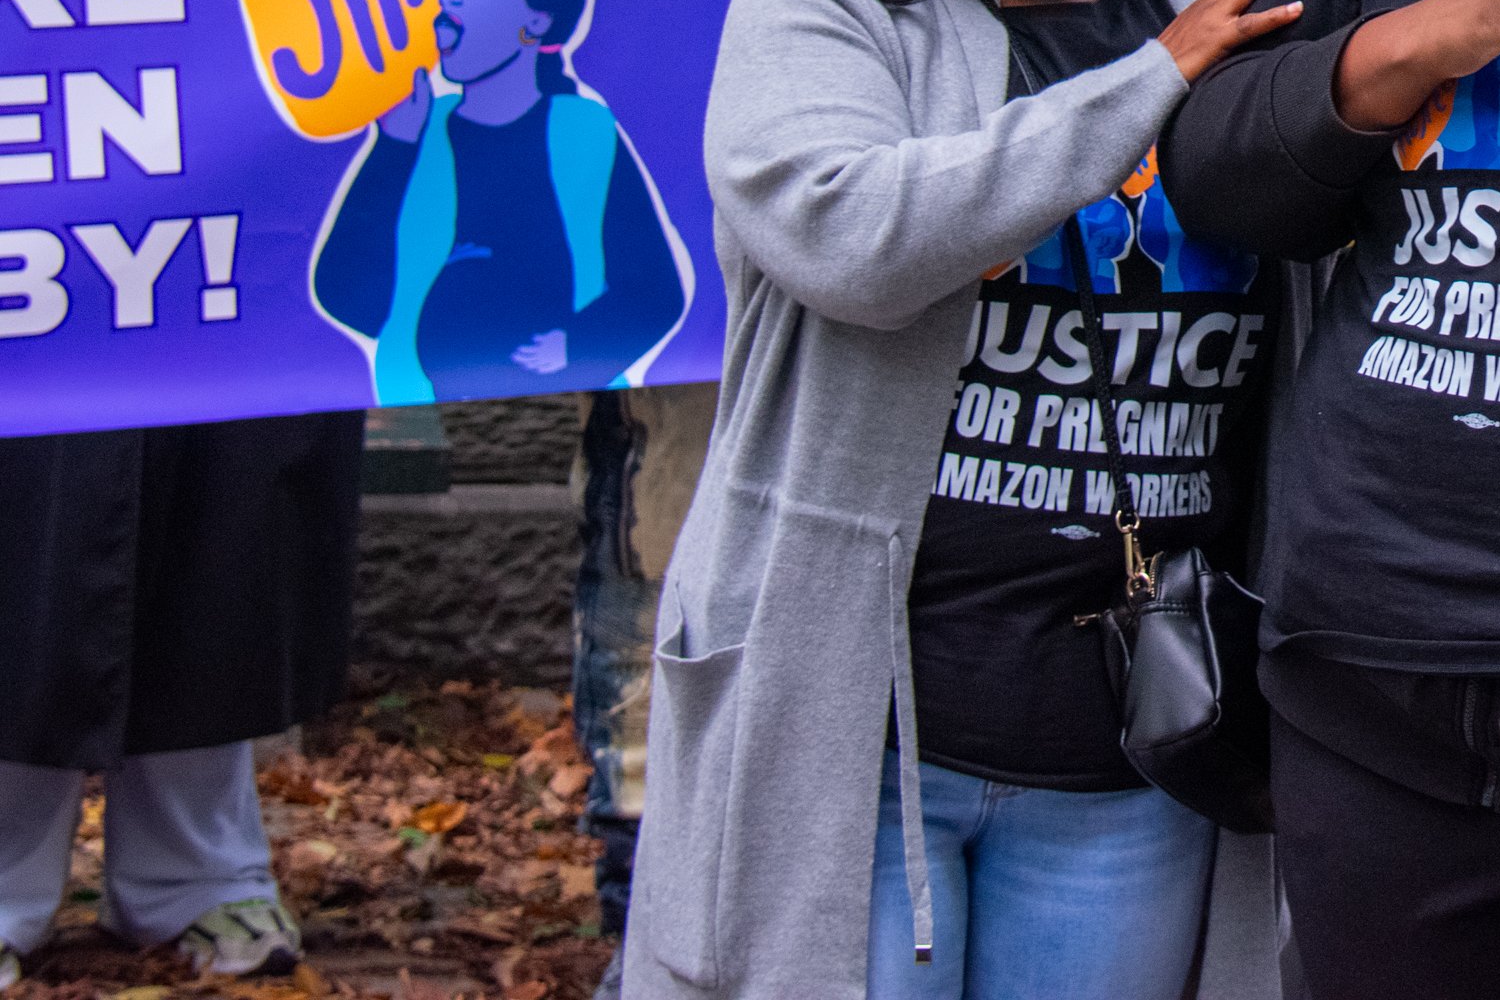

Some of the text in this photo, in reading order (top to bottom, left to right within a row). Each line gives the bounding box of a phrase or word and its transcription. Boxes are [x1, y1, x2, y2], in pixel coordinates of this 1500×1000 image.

[0, 214, 240, 339] BY!
[1372, 276, 1441, 330] FOR
[1357, 336, 1474, 398] AMAZON
[952, 380, 1021, 446] OR
[931, 452, 1074, 513] MAZON
